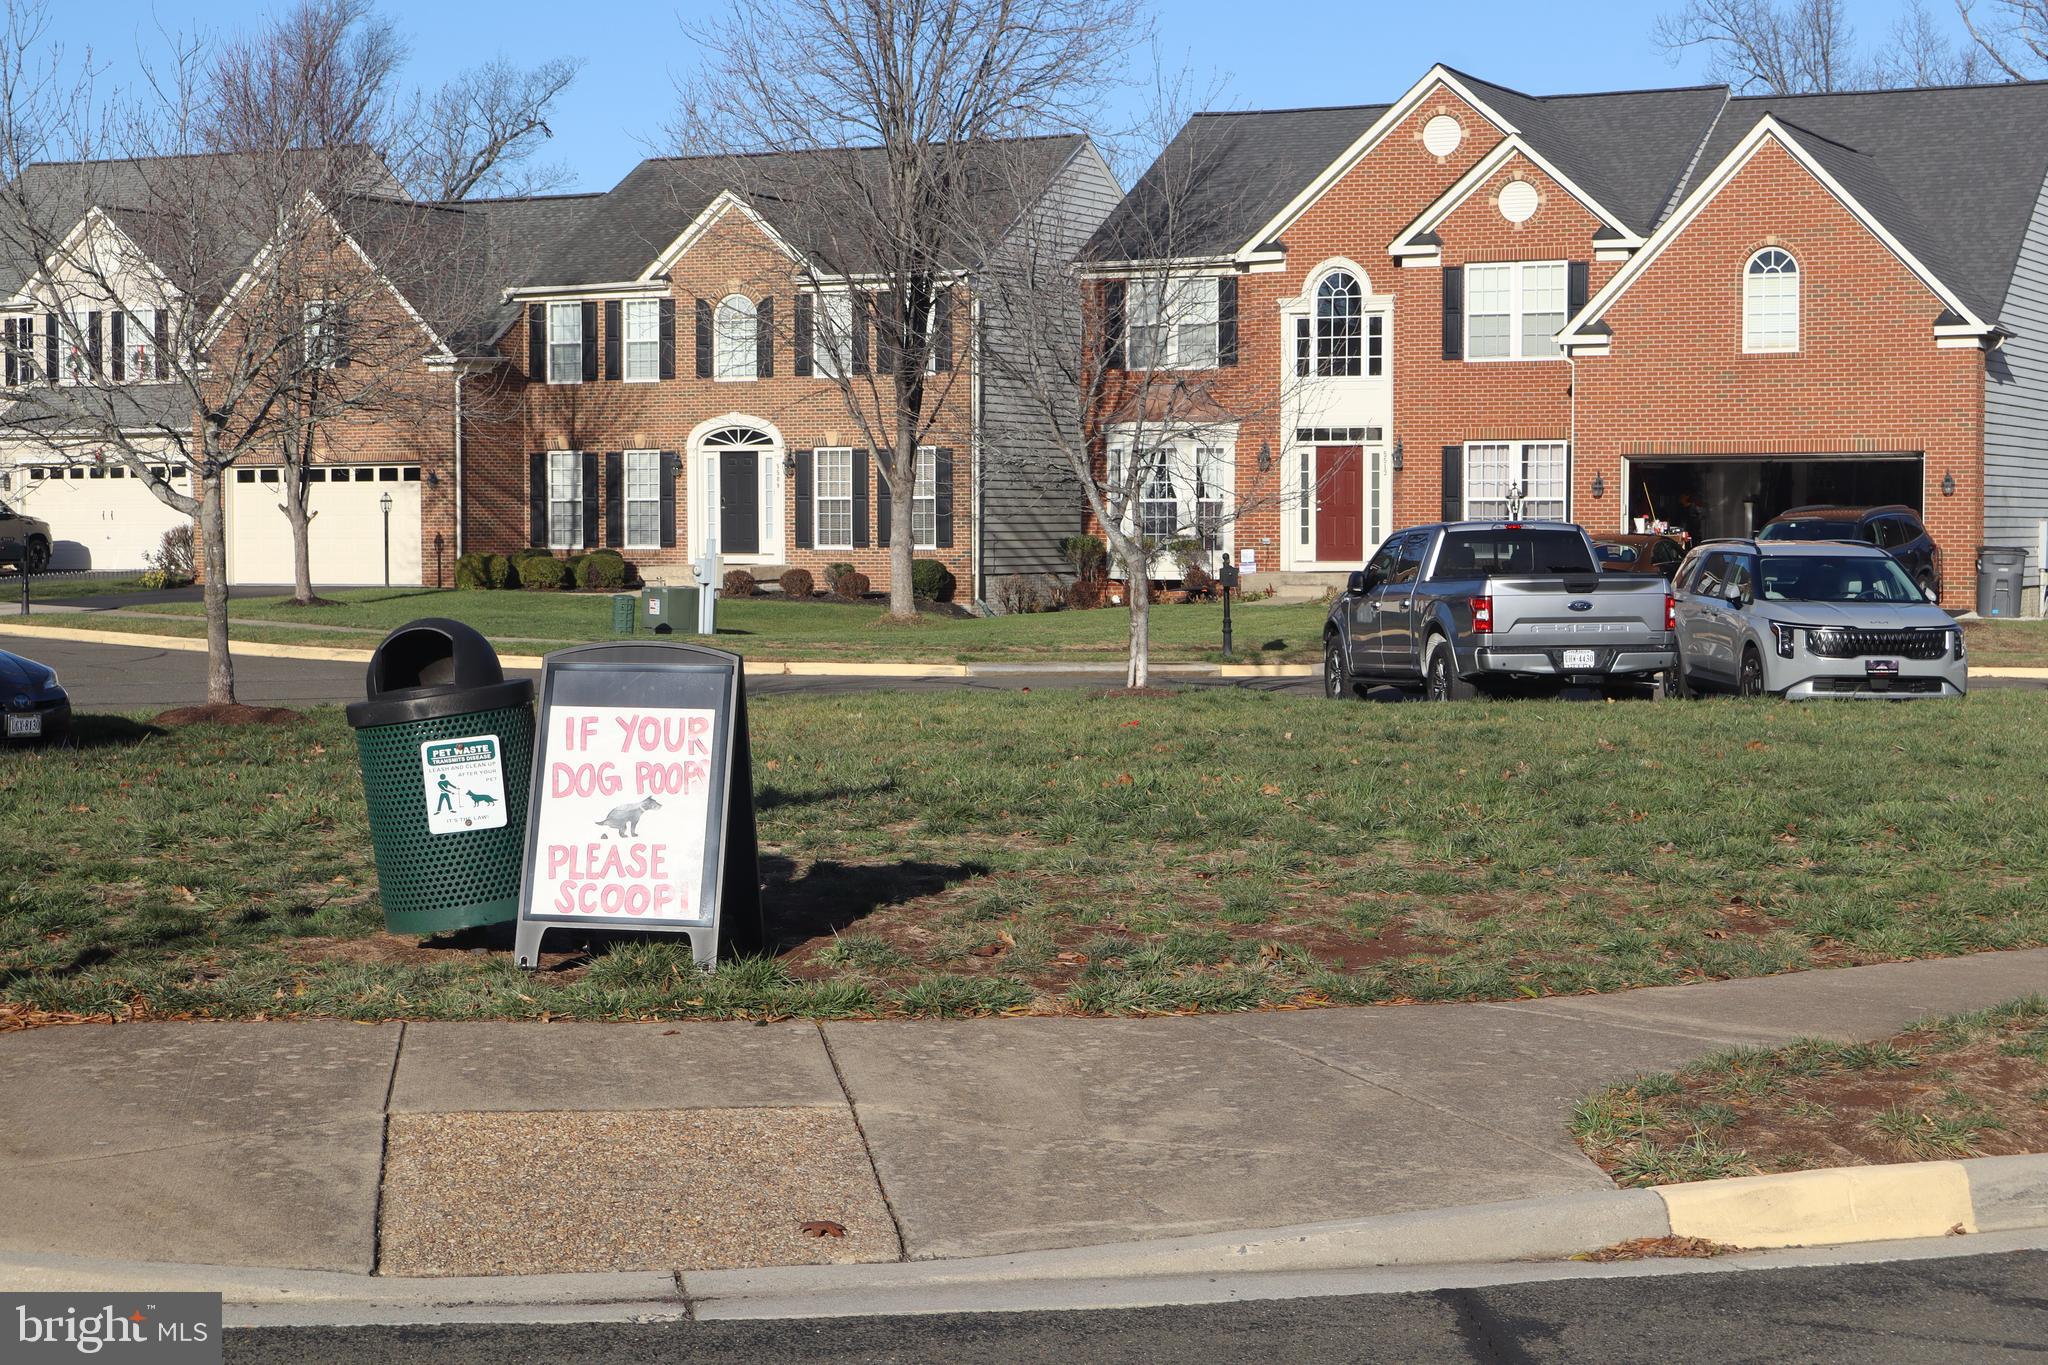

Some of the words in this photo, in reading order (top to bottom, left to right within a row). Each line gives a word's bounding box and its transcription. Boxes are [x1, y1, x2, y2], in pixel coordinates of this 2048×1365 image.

[432, 748, 451, 757] PET
[454, 745, 489, 755] WASTE
[565, 716, 599, 751] IF
[615, 714, 709, 756] YOUR
[428, 766, 450, 774] LEASH
[465, 762, 487, 770] CLEAN
[433, 757, 465, 765] TRANSMITS
[552, 761, 622, 798] DOG
[548, 843, 668, 879] PLEASE
[554, 879, 690, 916] SCOOP!
